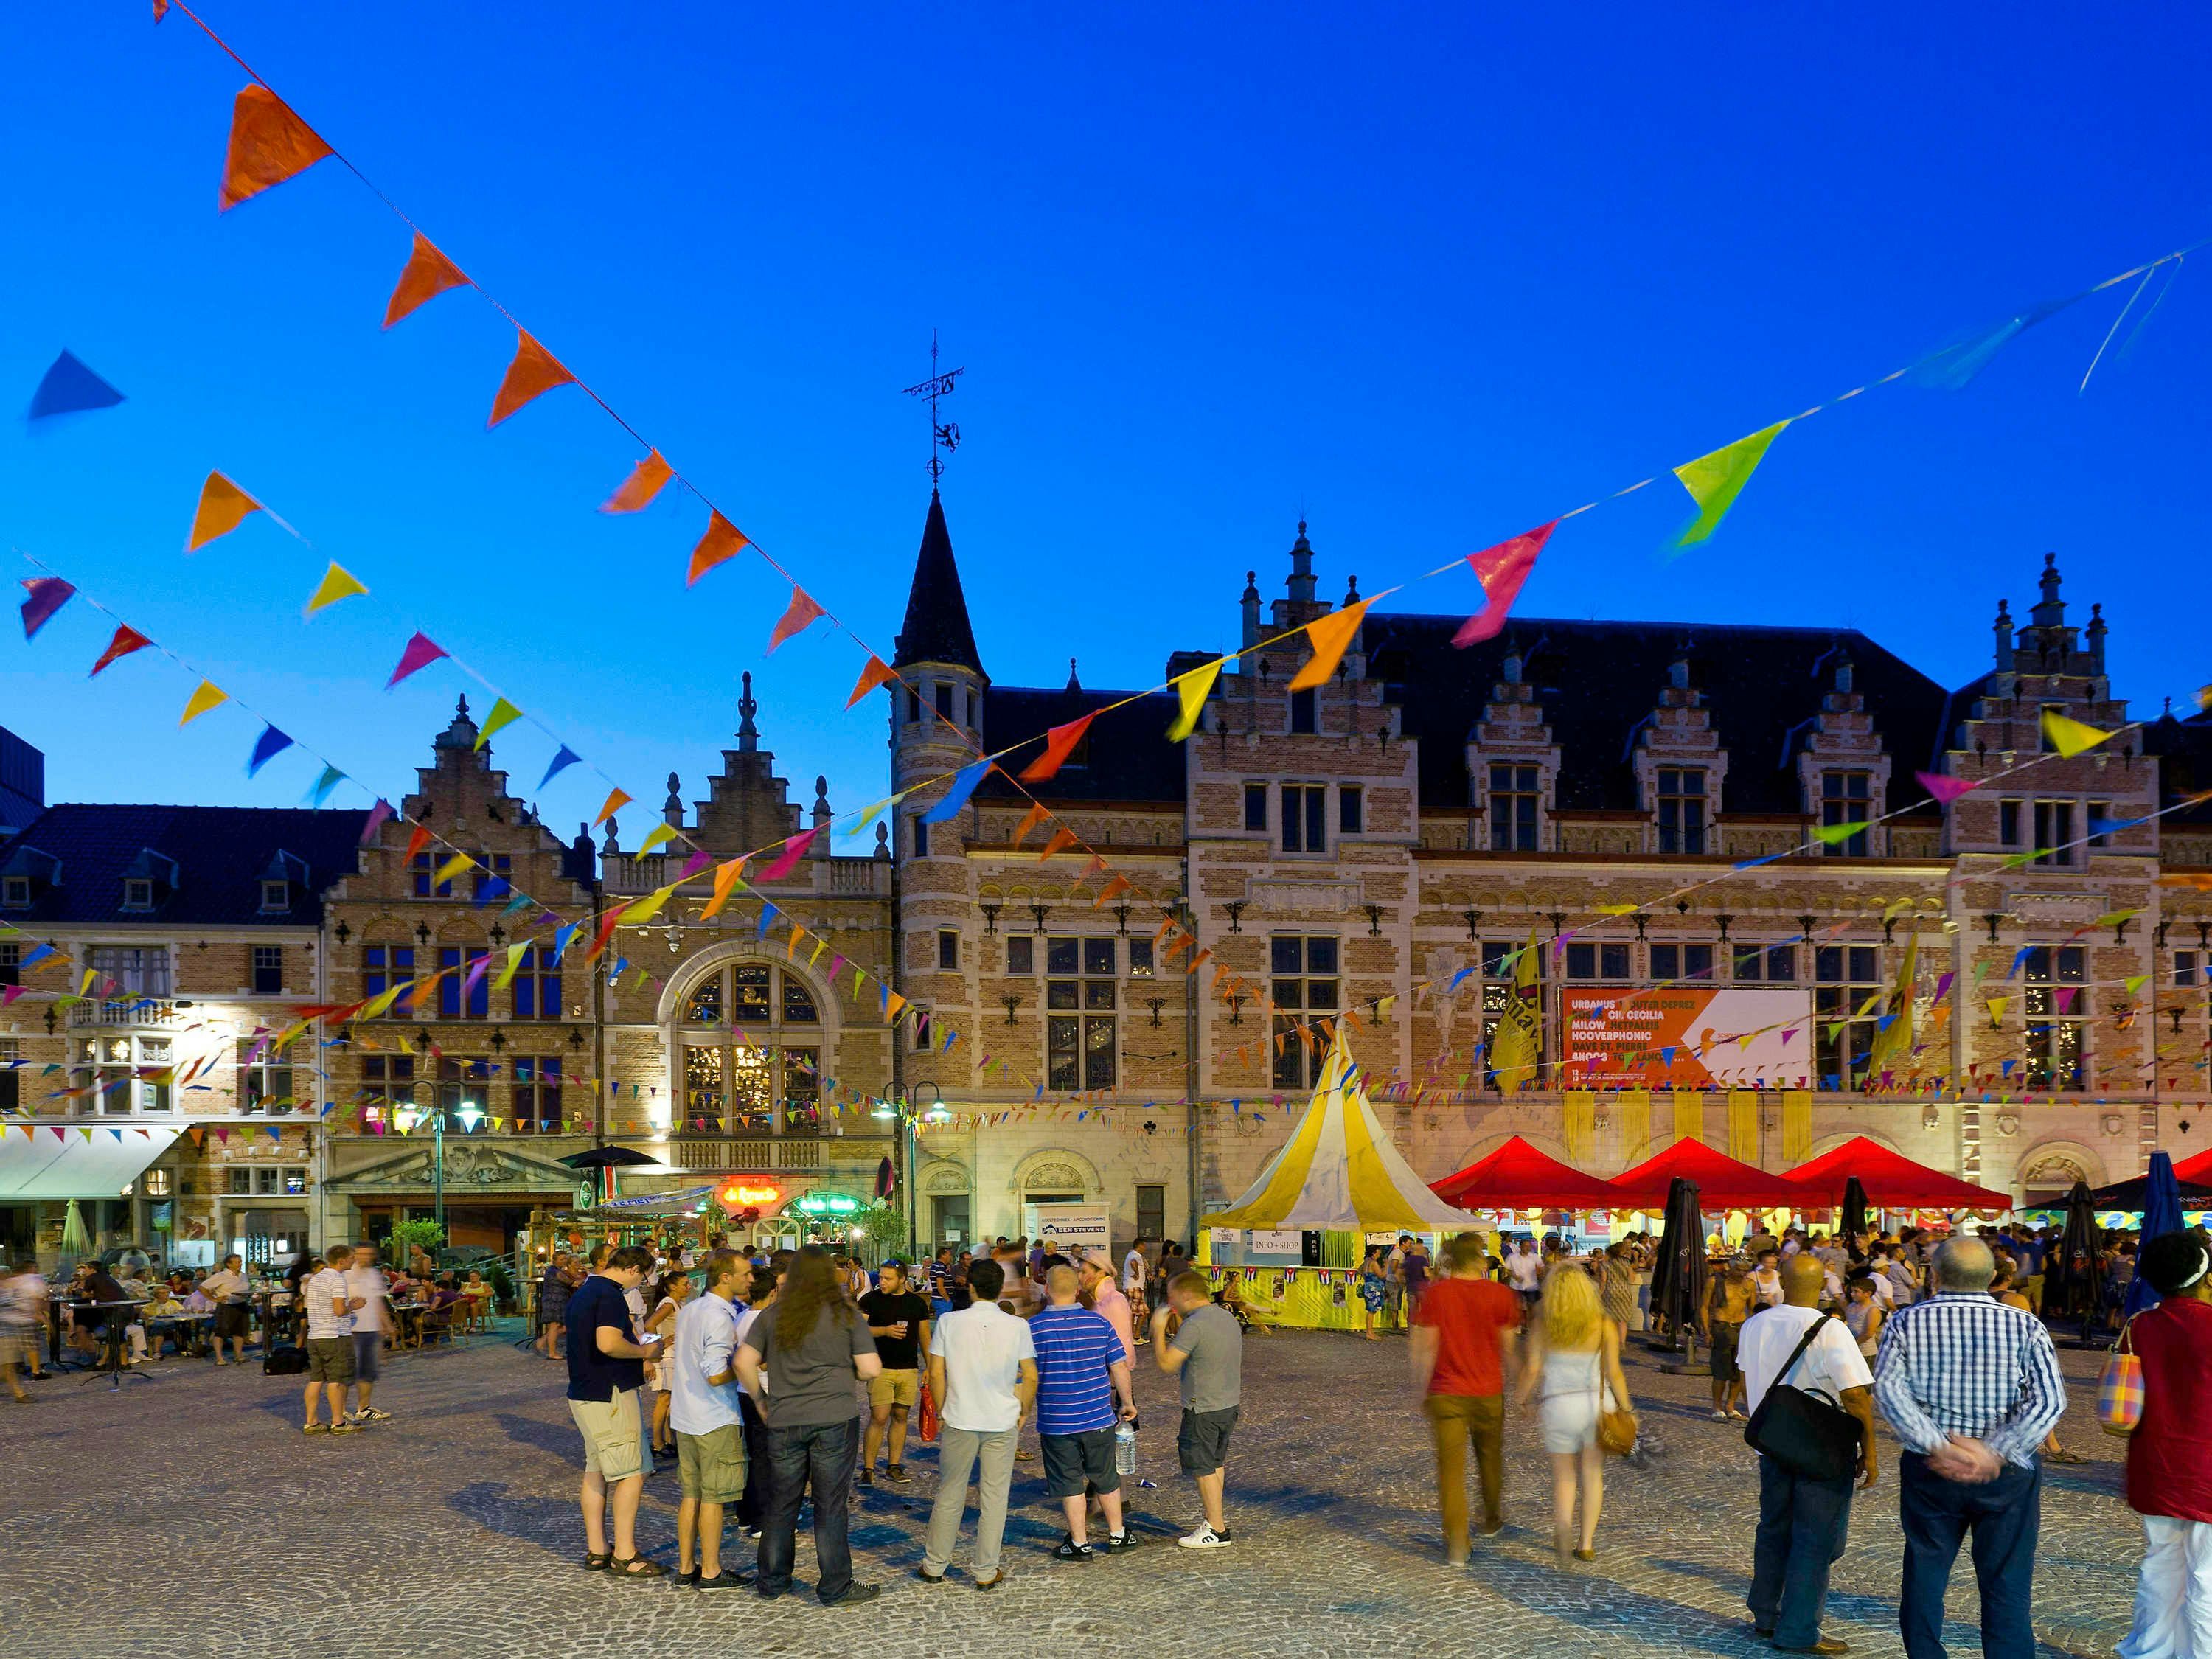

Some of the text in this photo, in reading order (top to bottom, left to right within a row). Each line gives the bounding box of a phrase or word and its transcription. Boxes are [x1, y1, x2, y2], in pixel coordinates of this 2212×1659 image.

[1572, 1000, 1615, 1009] URBANUS
[1661, 1000, 1695, 1009] DEPREZ
[1572, 1010, 1603, 1019] ROSS
[1627, 1010, 1664, 1020] CECILIA
[1572, 1020, 1606, 1030] MILOW
[1572, 1031, 1652, 1040] HOOVERPHONIC
[1572, 1042, 1647, 1051] DAVE ST. PIERRE
[1256, 1241, 1273, 1249] INFO
[1279, 1241, 1298, 1249] SHOP
